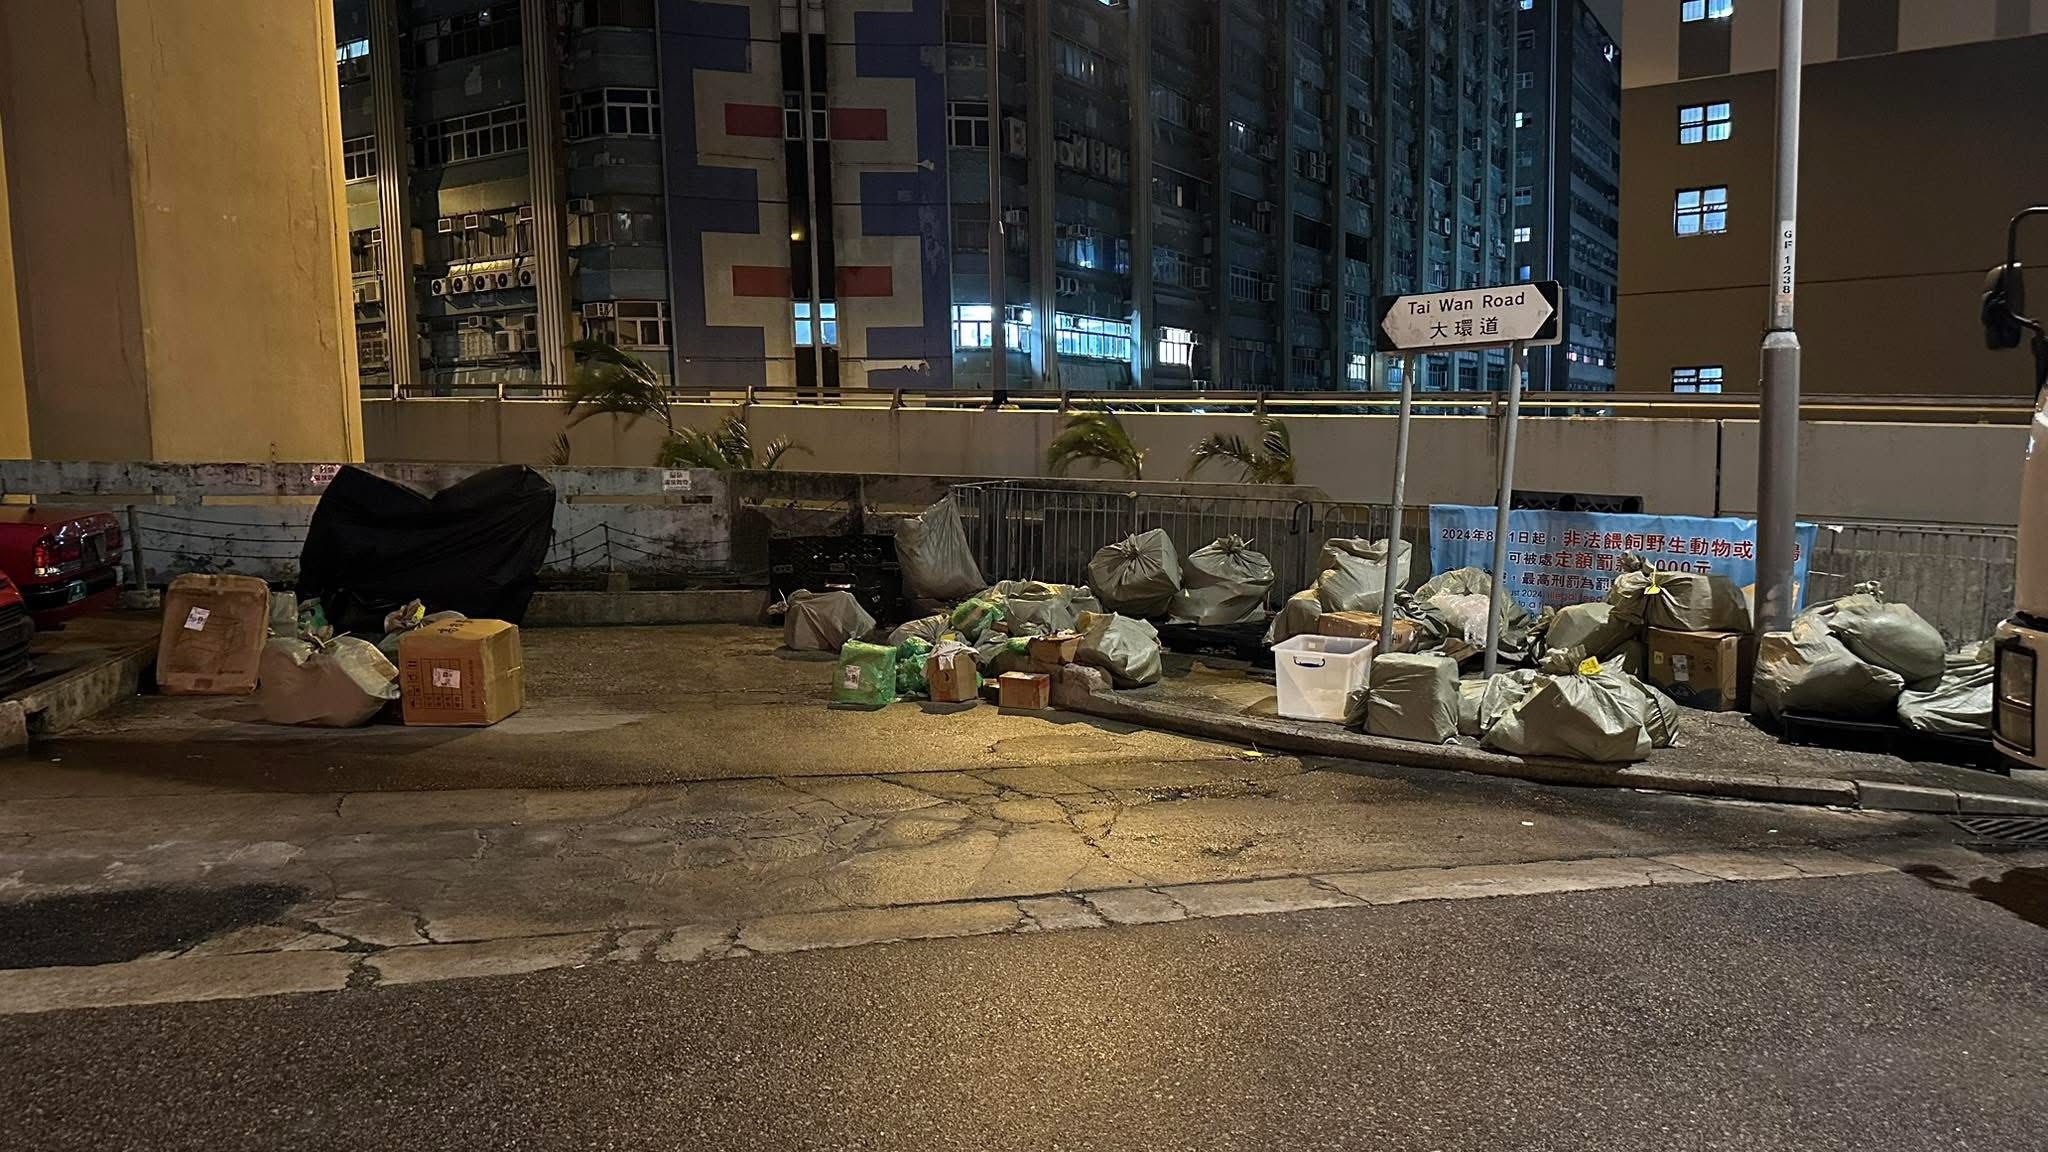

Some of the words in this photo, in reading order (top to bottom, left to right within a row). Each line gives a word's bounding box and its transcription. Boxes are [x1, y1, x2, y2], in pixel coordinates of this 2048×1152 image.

[1782, 256, 1792, 294] 1238
[1408, 301, 1431, 315] Tai
[1439, 298, 1473, 312] Wan
[1482, 292, 1525, 309] Road
[1430, 317, 1499, 339] 大環道
